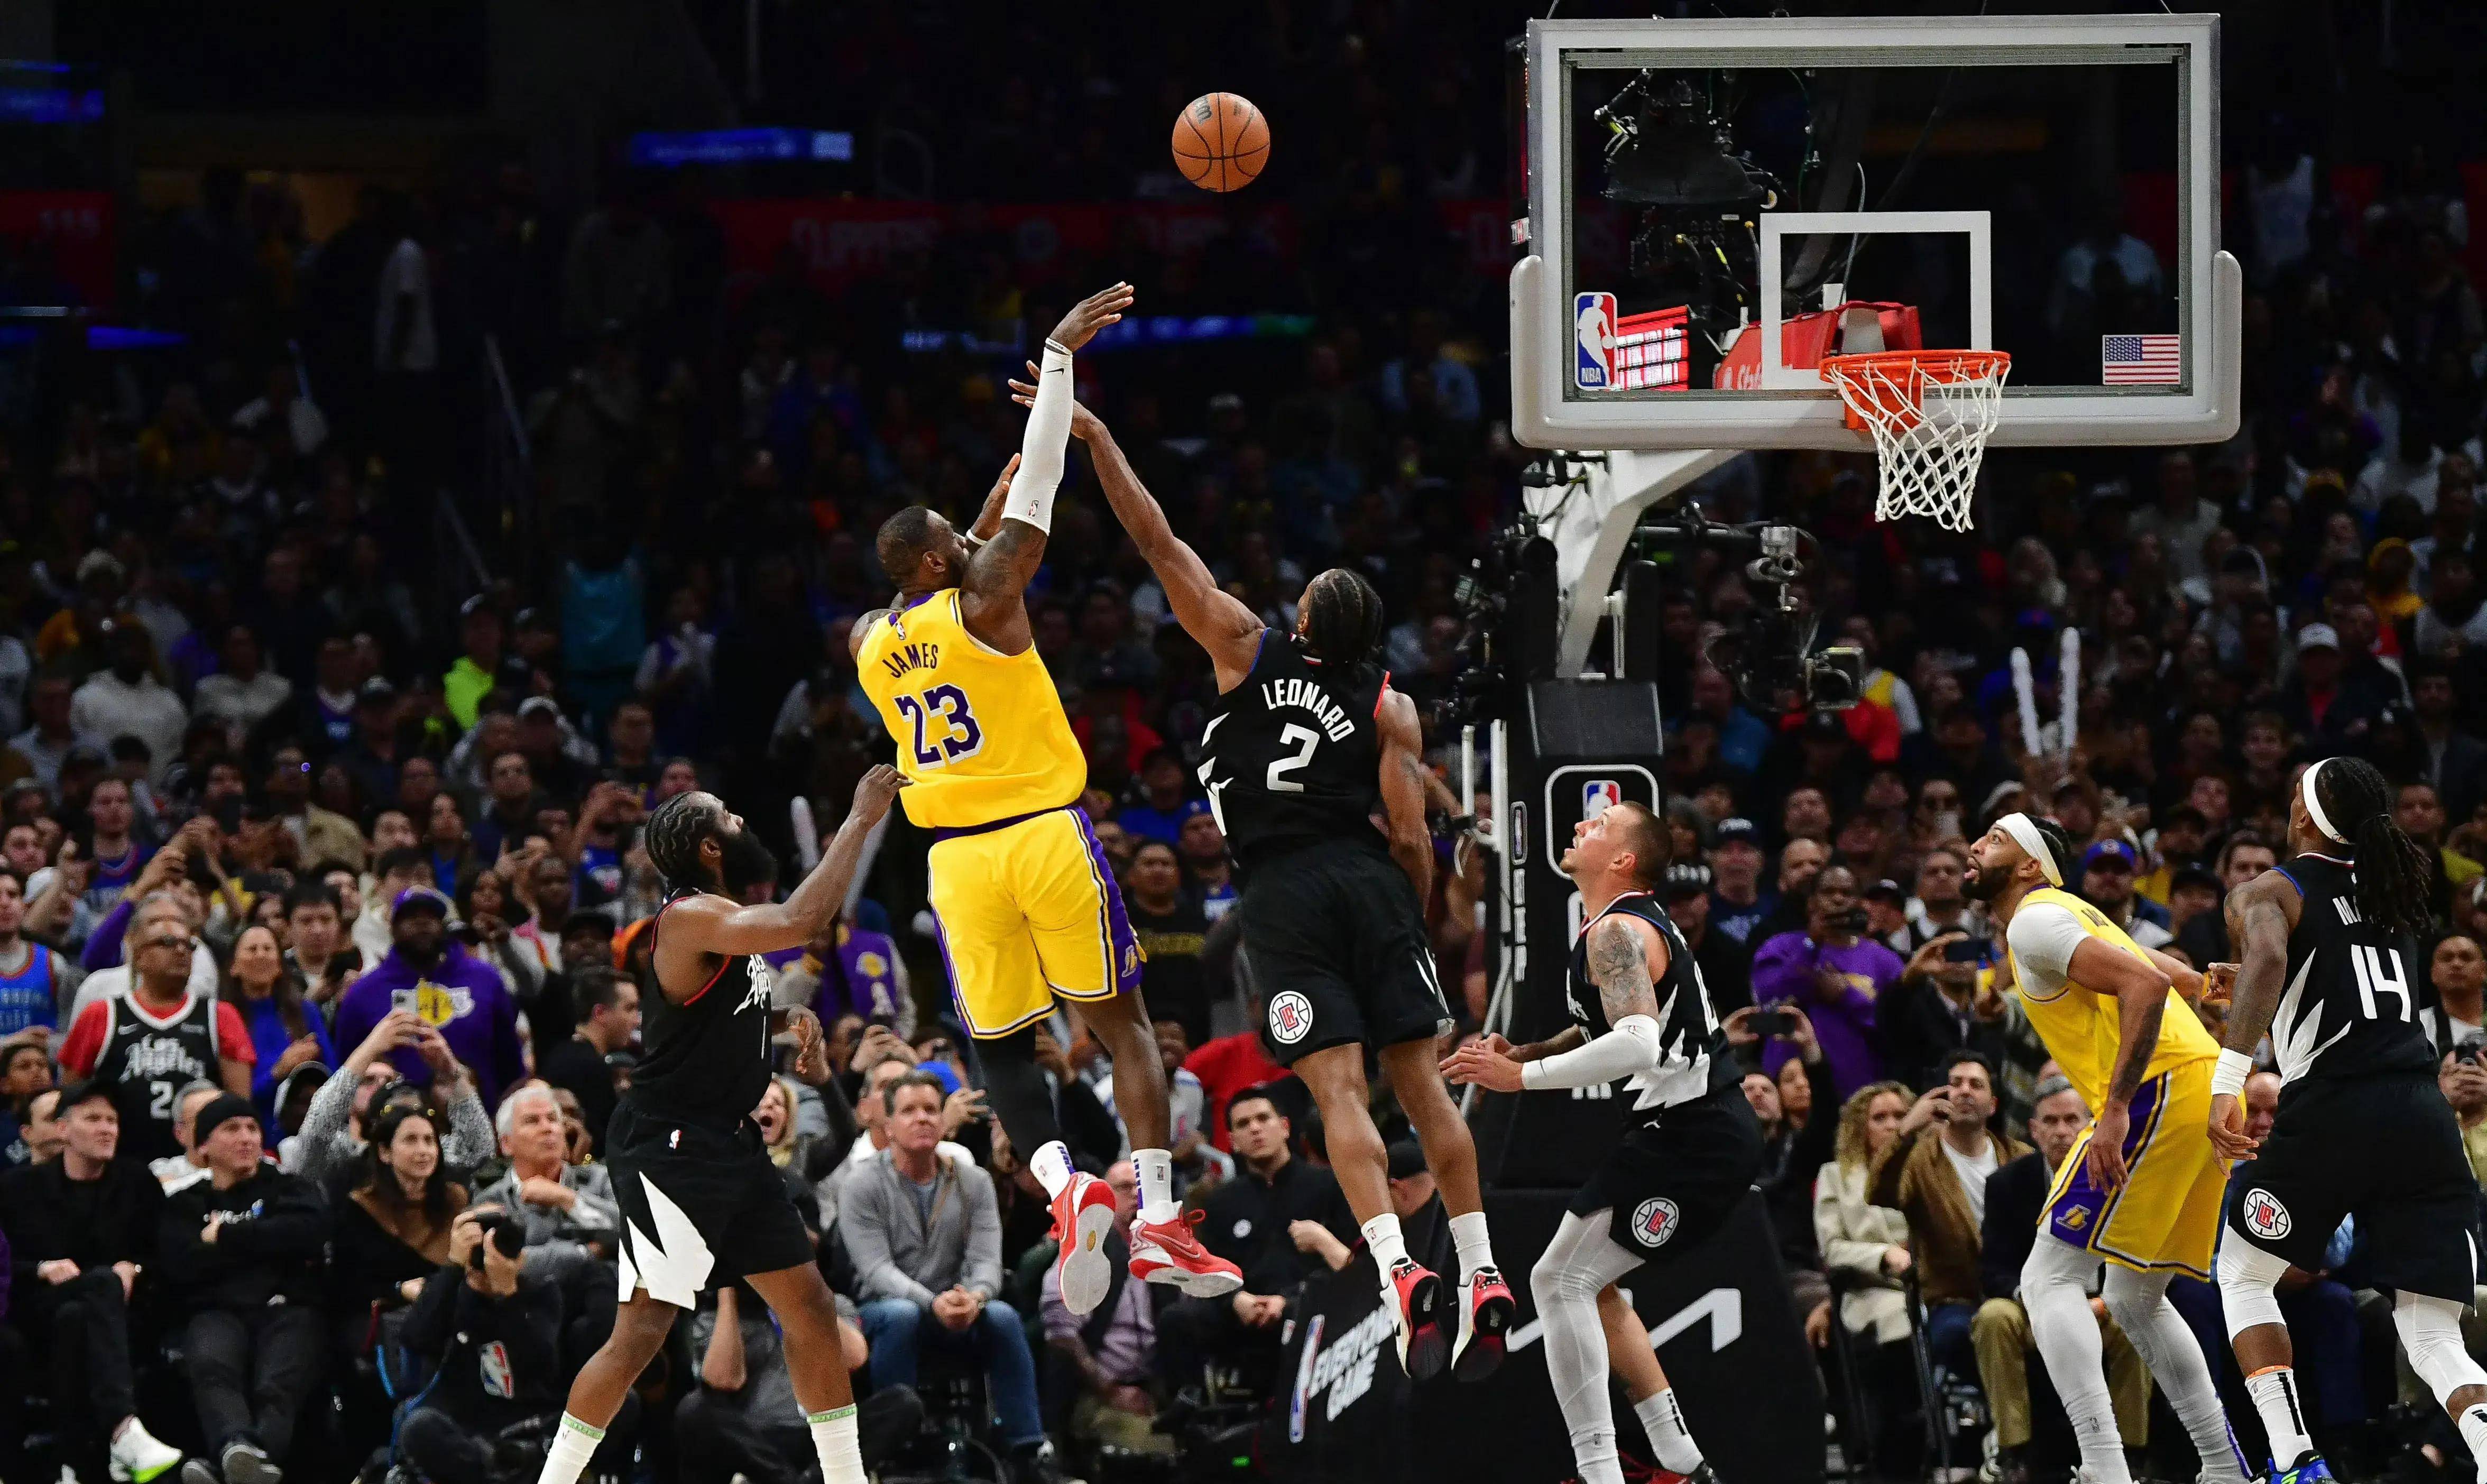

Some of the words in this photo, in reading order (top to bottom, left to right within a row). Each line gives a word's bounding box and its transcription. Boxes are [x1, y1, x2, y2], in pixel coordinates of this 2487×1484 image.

[1581, 367, 1602, 383] NBA
[882, 643, 938, 678] JAMES
[892, 683, 985, 771] 23
[1261, 678, 1355, 742] LEONARD
[1267, 722, 1320, 793] 2
[2351, 944, 2411, 1022] 14
[150, 1081, 173, 1119] 2
